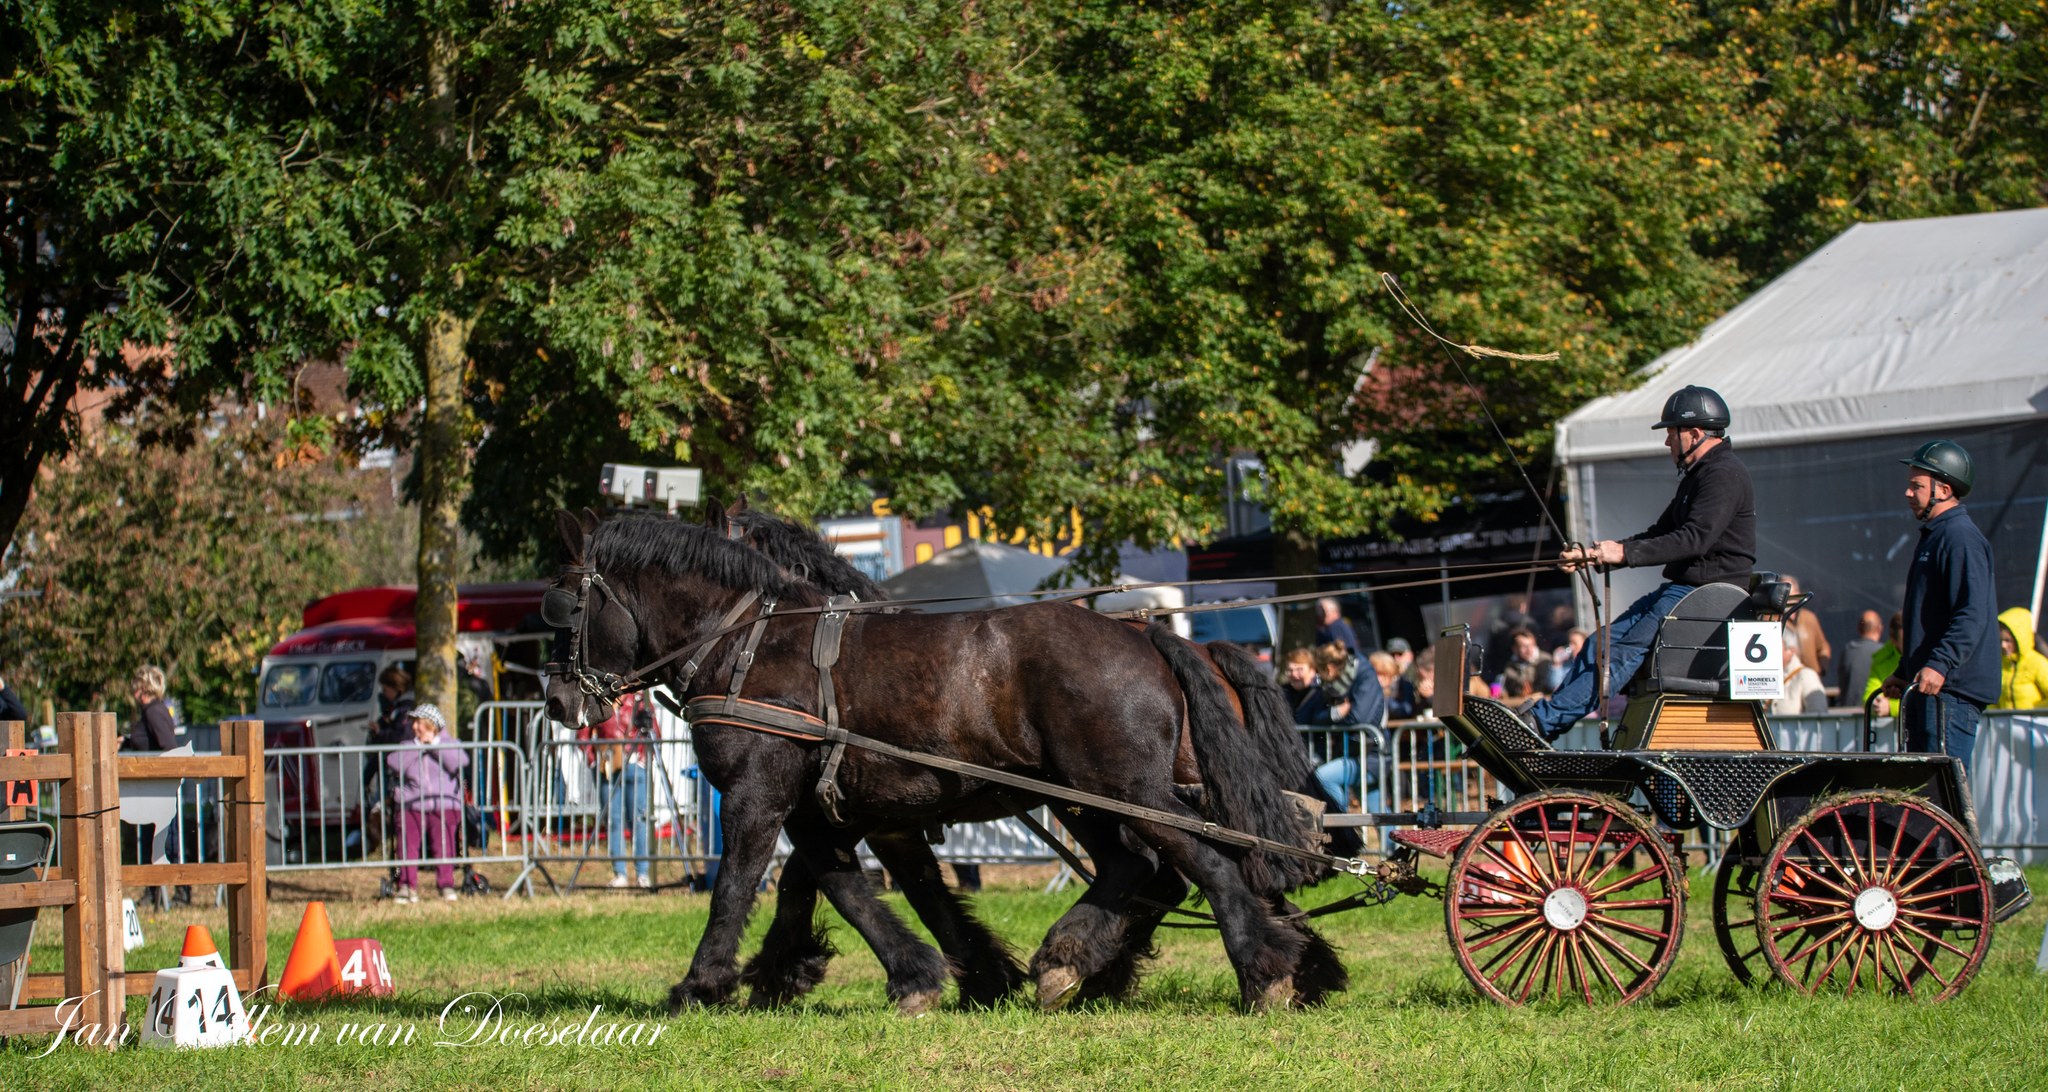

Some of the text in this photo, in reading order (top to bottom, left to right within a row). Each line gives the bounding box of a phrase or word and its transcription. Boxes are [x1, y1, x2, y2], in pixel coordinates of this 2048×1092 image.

[1744, 633, 1768, 663] 6
[126, 910, 139, 936] 20
[336, 949, 367, 988] 4
[372, 949, 392, 988] 14
[151, 986, 175, 1034] 14
[187, 984, 235, 1034] 14
